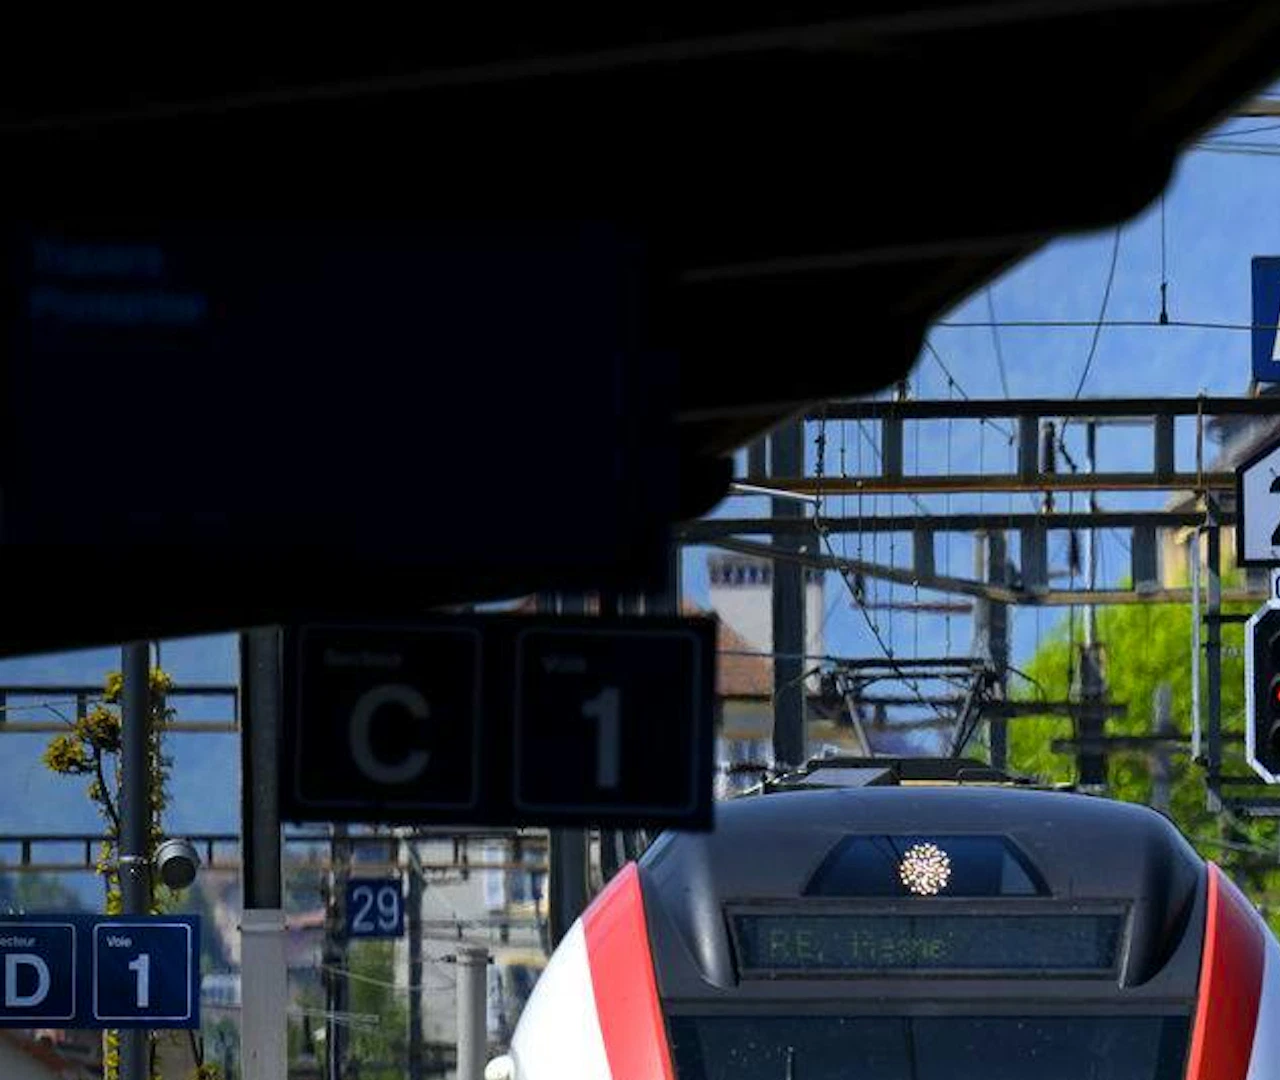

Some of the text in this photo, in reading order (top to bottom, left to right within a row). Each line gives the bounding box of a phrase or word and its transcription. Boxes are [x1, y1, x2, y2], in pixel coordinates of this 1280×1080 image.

[348, 683, 431, 785] C
[580, 686, 622, 790] 1
[351, 886, 400, 932] 29
[0, 935, 36, 948] ecteur
[106, 935, 134, 948] Voie
[4, 953, 51, 1008] D
[127, 953, 151, 1008] 1
